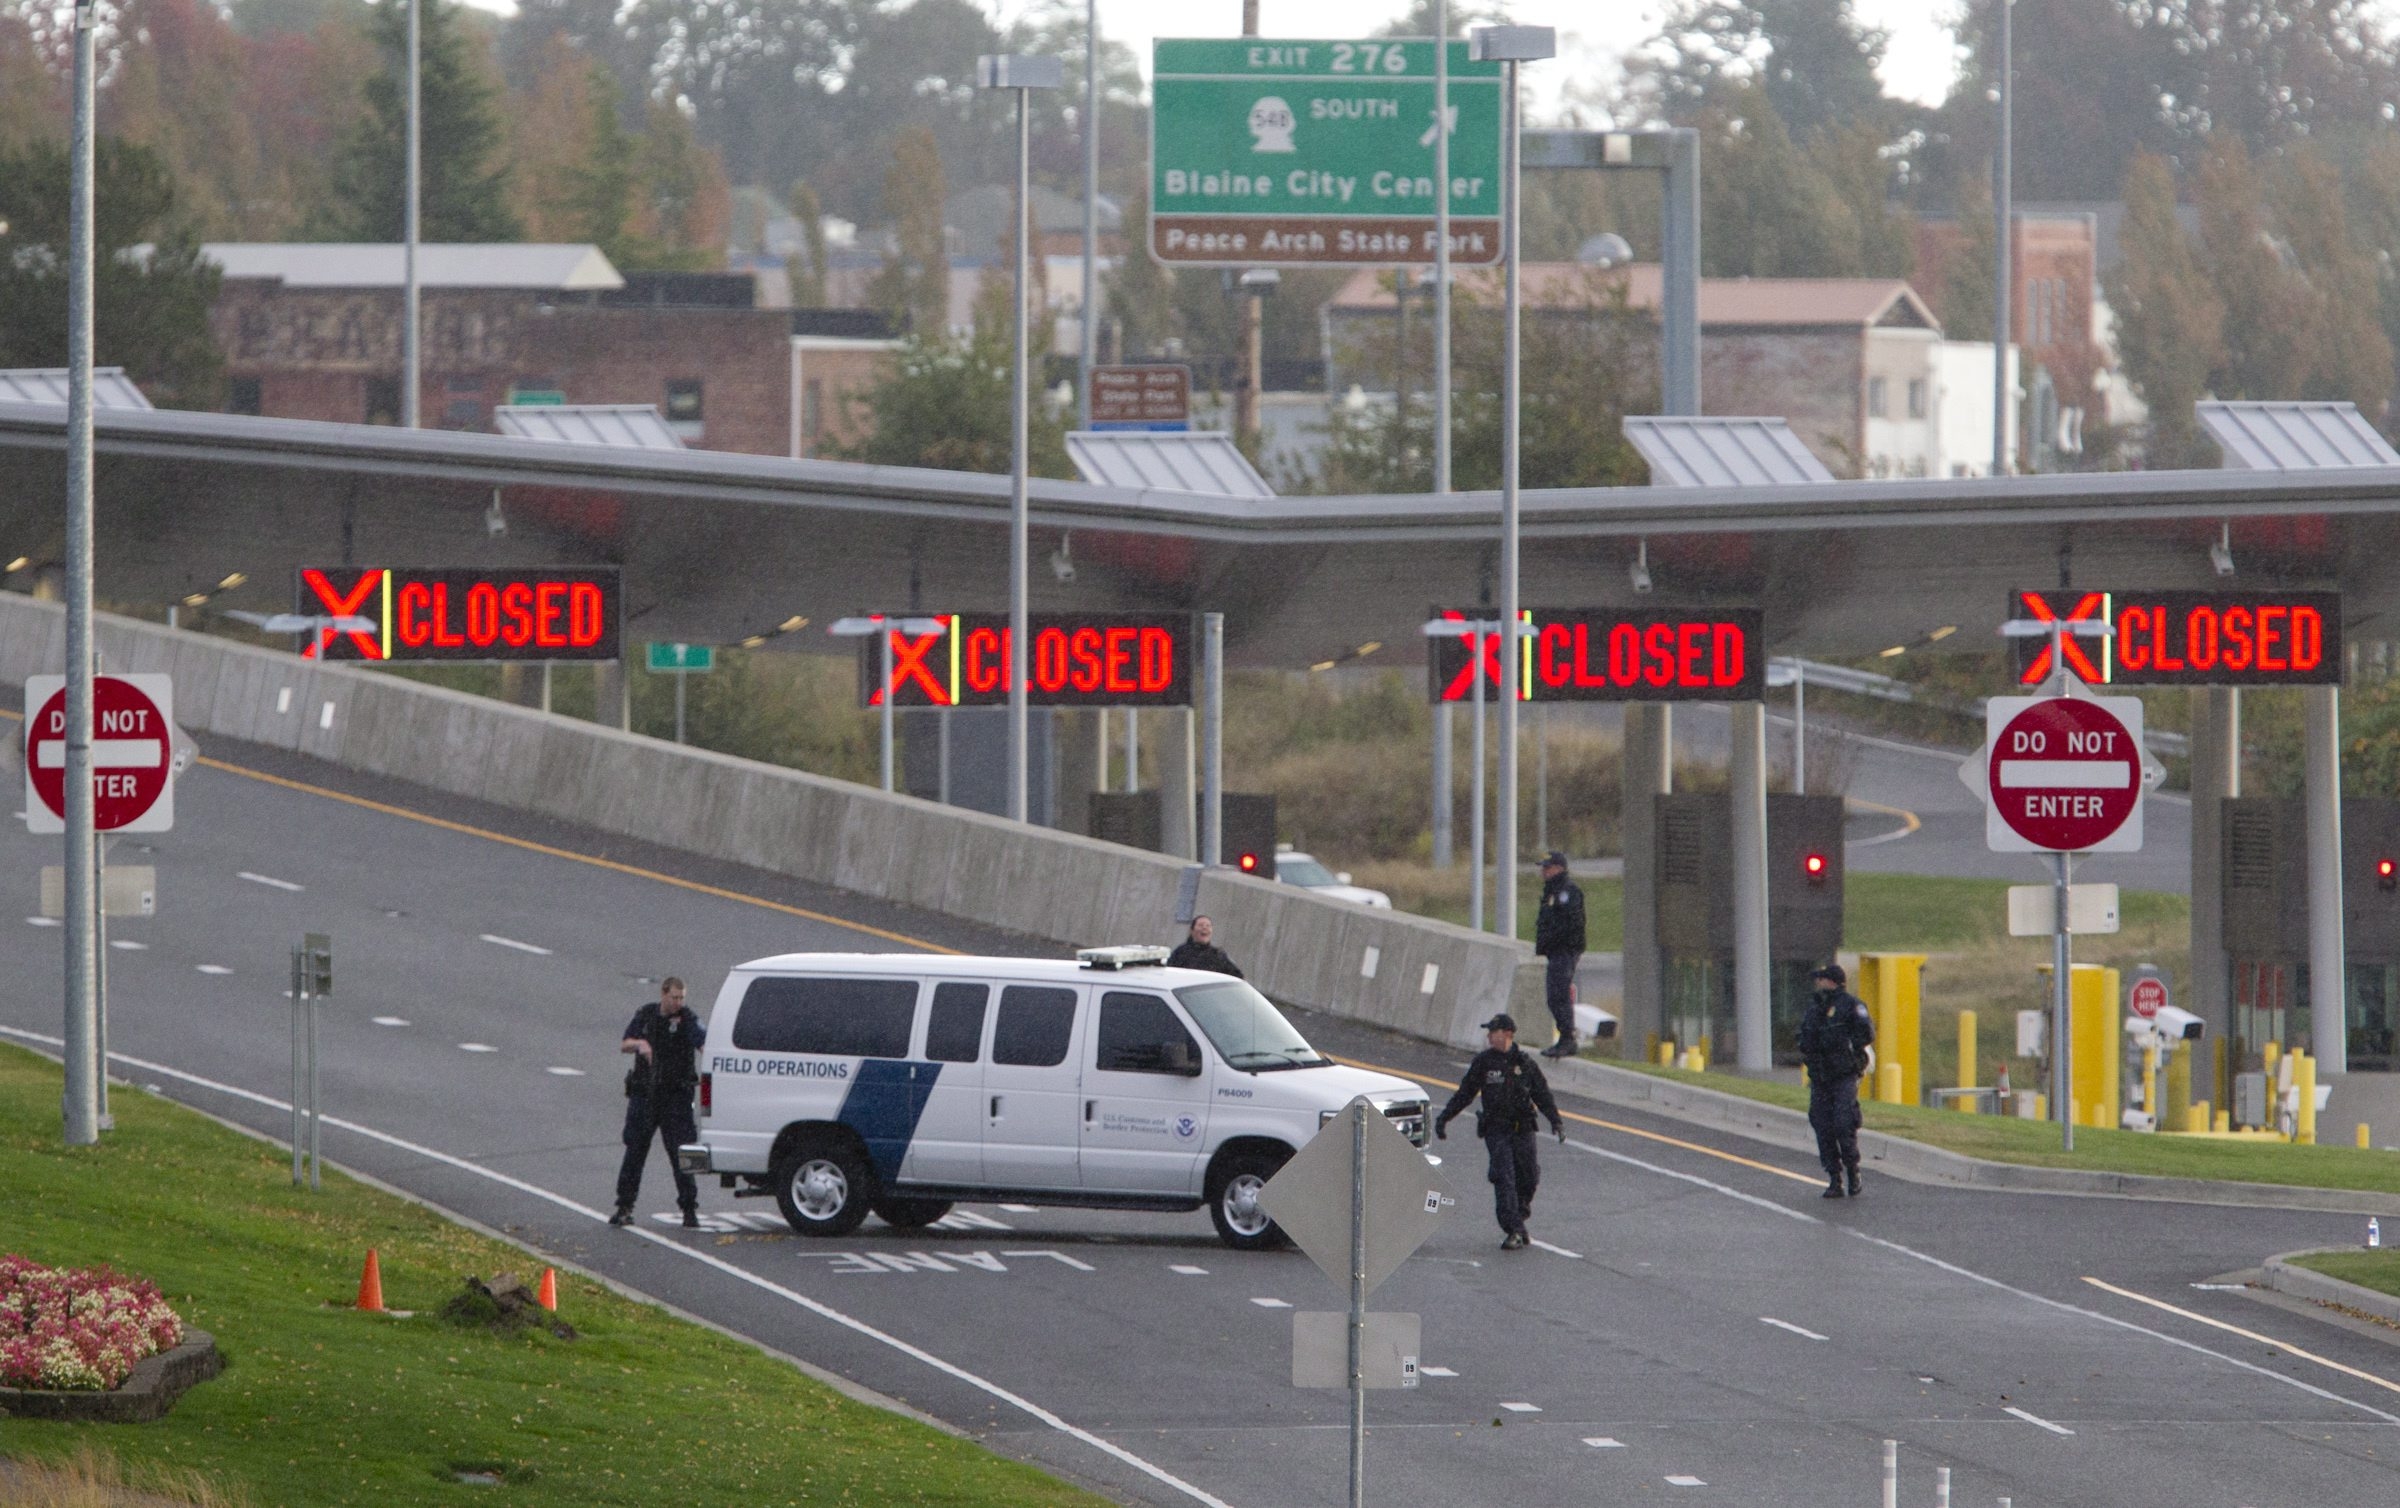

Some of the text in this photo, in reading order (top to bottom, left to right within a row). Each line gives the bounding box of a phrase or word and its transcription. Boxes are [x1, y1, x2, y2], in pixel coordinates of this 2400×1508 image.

[1247, 43, 1407, 73] EXIT 276
[1311, 98, 1398, 119] SOUTH
[1165, 169, 1485, 202] Blaine City Cener
[1166, 229, 1247, 251] Peace
[1260, 229, 1325, 251] Arch
[1338, 229, 1410, 251] State
[399, 582, 603, 647] CLOSED
[2118, 606, 2322, 671] CLOSED
[967, 627, 1173, 693] CLOSED
[1539, 623, 1745, 688] CLOSED
[102, 709, 148, 732] NOT
[2013, 731, 2117, 754] DO NOT
[62, 775, 137, 798] TER
[2025, 795, 2104, 818] ENTER
[711, 1056, 848, 1079] FIELD OPERATIONS
